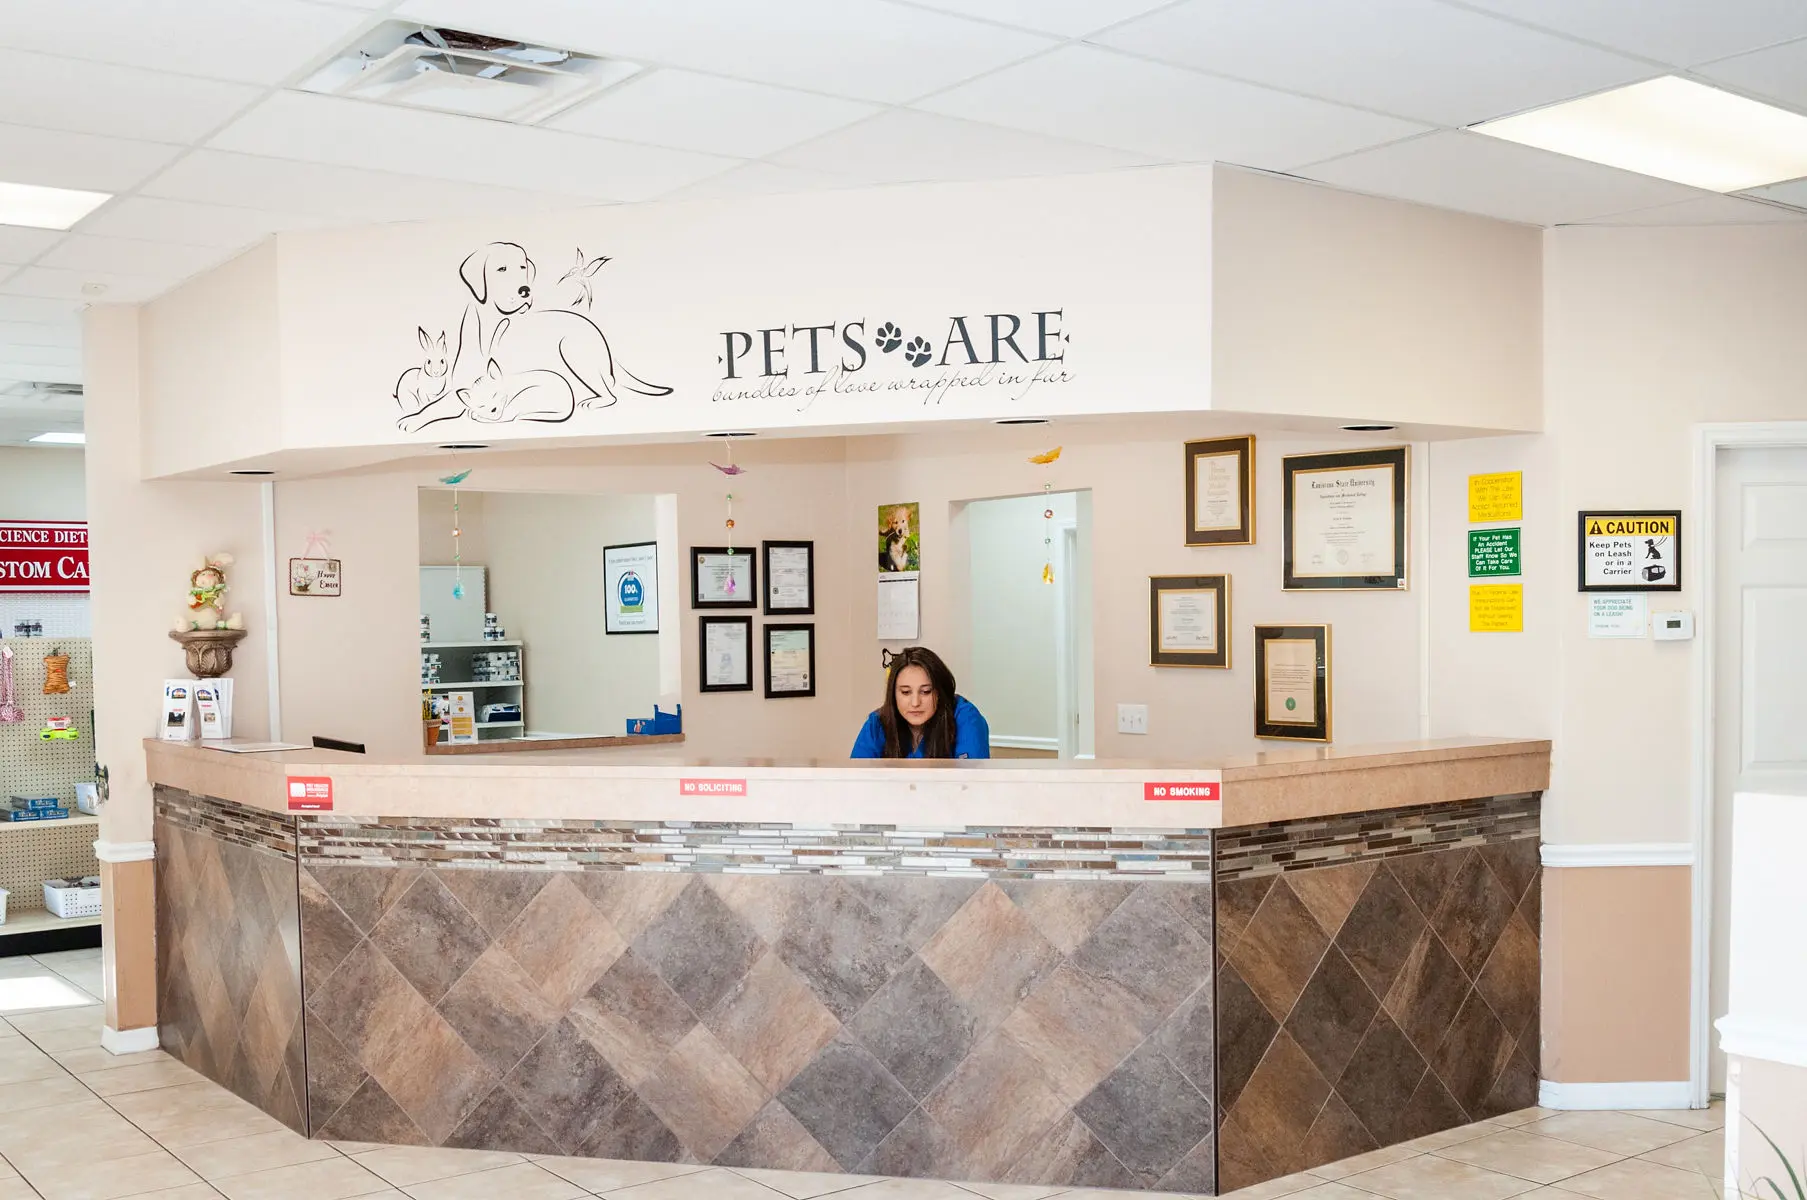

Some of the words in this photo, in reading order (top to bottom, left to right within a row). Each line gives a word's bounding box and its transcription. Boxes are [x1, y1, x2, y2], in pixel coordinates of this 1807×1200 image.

[720, 317, 866, 380] PETS
[935, 307, 1066, 367] ARE
[712, 369, 799, 403] bundles
[833, 364, 884, 395] love
[887, 362, 997, 406] wrapped
[997, 371, 1025, 385] in
[1010, 353, 1077, 402] fur
[54, 530, 87, 543] DIET
[1606, 521, 1669, 534] CAUTION
[1589, 541, 1611, 549] Keep
[57, 556, 89, 579] CA
[684, 783, 695, 792] NO
[698, 783, 743, 792] SOLICITING
[1153, 786, 1167, 797] NO
[1169, 786, 1211, 797] SMOKING
